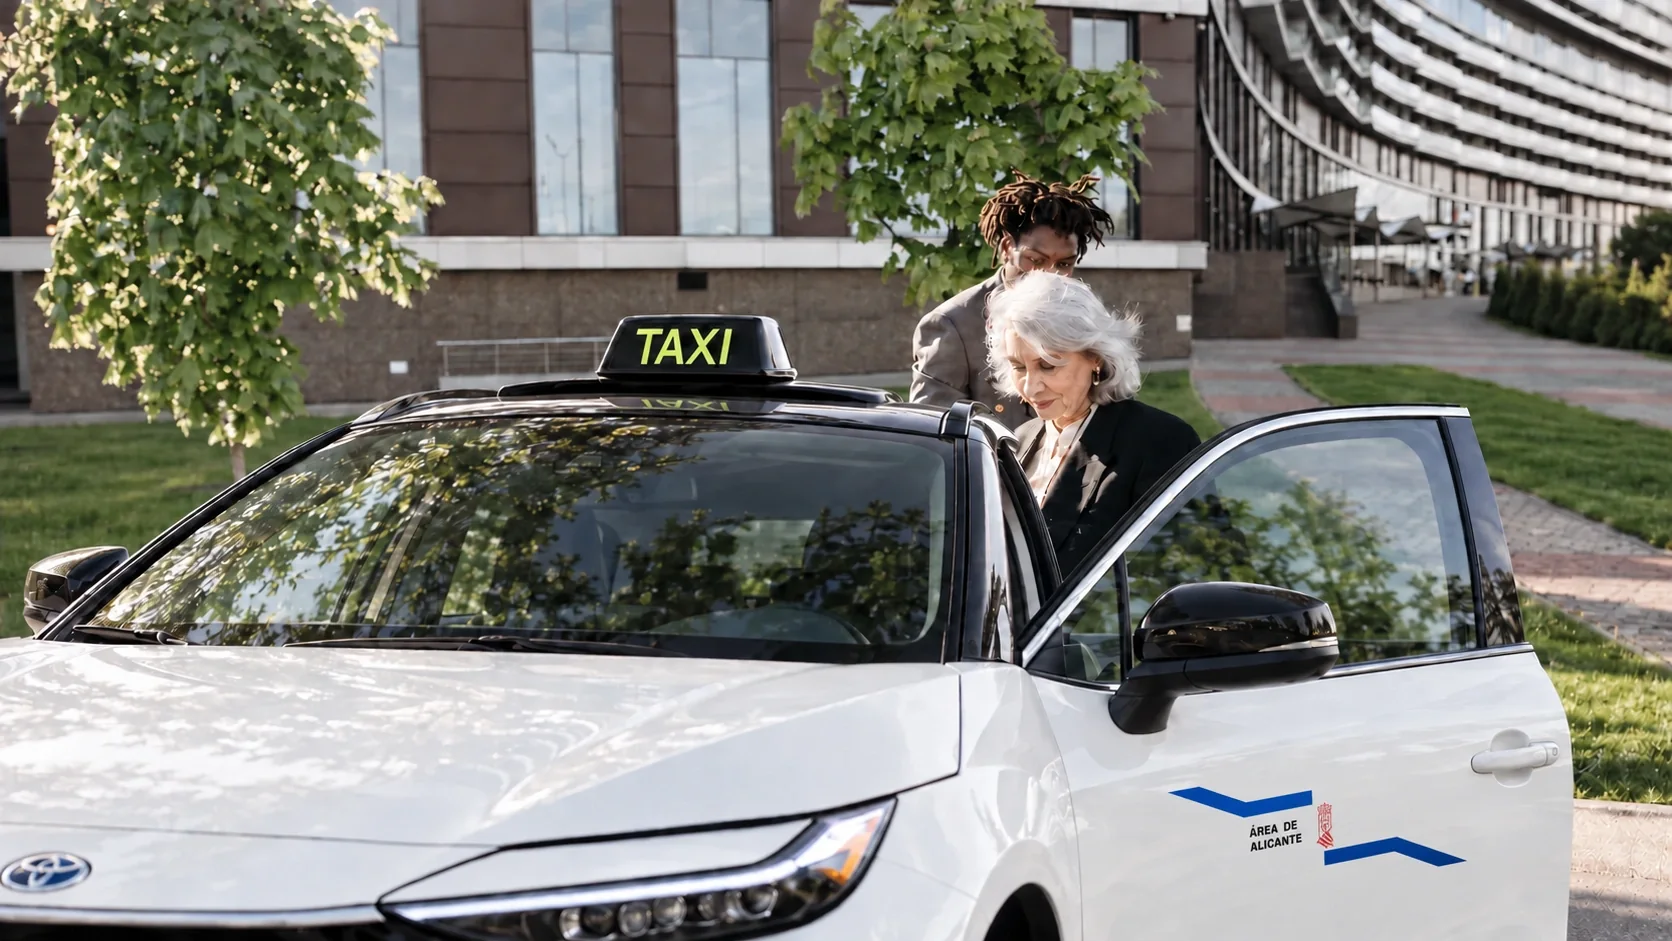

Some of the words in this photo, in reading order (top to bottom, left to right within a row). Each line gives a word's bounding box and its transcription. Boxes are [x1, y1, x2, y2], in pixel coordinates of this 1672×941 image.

[636, 328, 732, 365] TAXI
[1249, 824, 1278, 838] ÁREA
[1283, 820, 1298, 832] DE
[1250, 833, 1302, 852] ALICANTE
